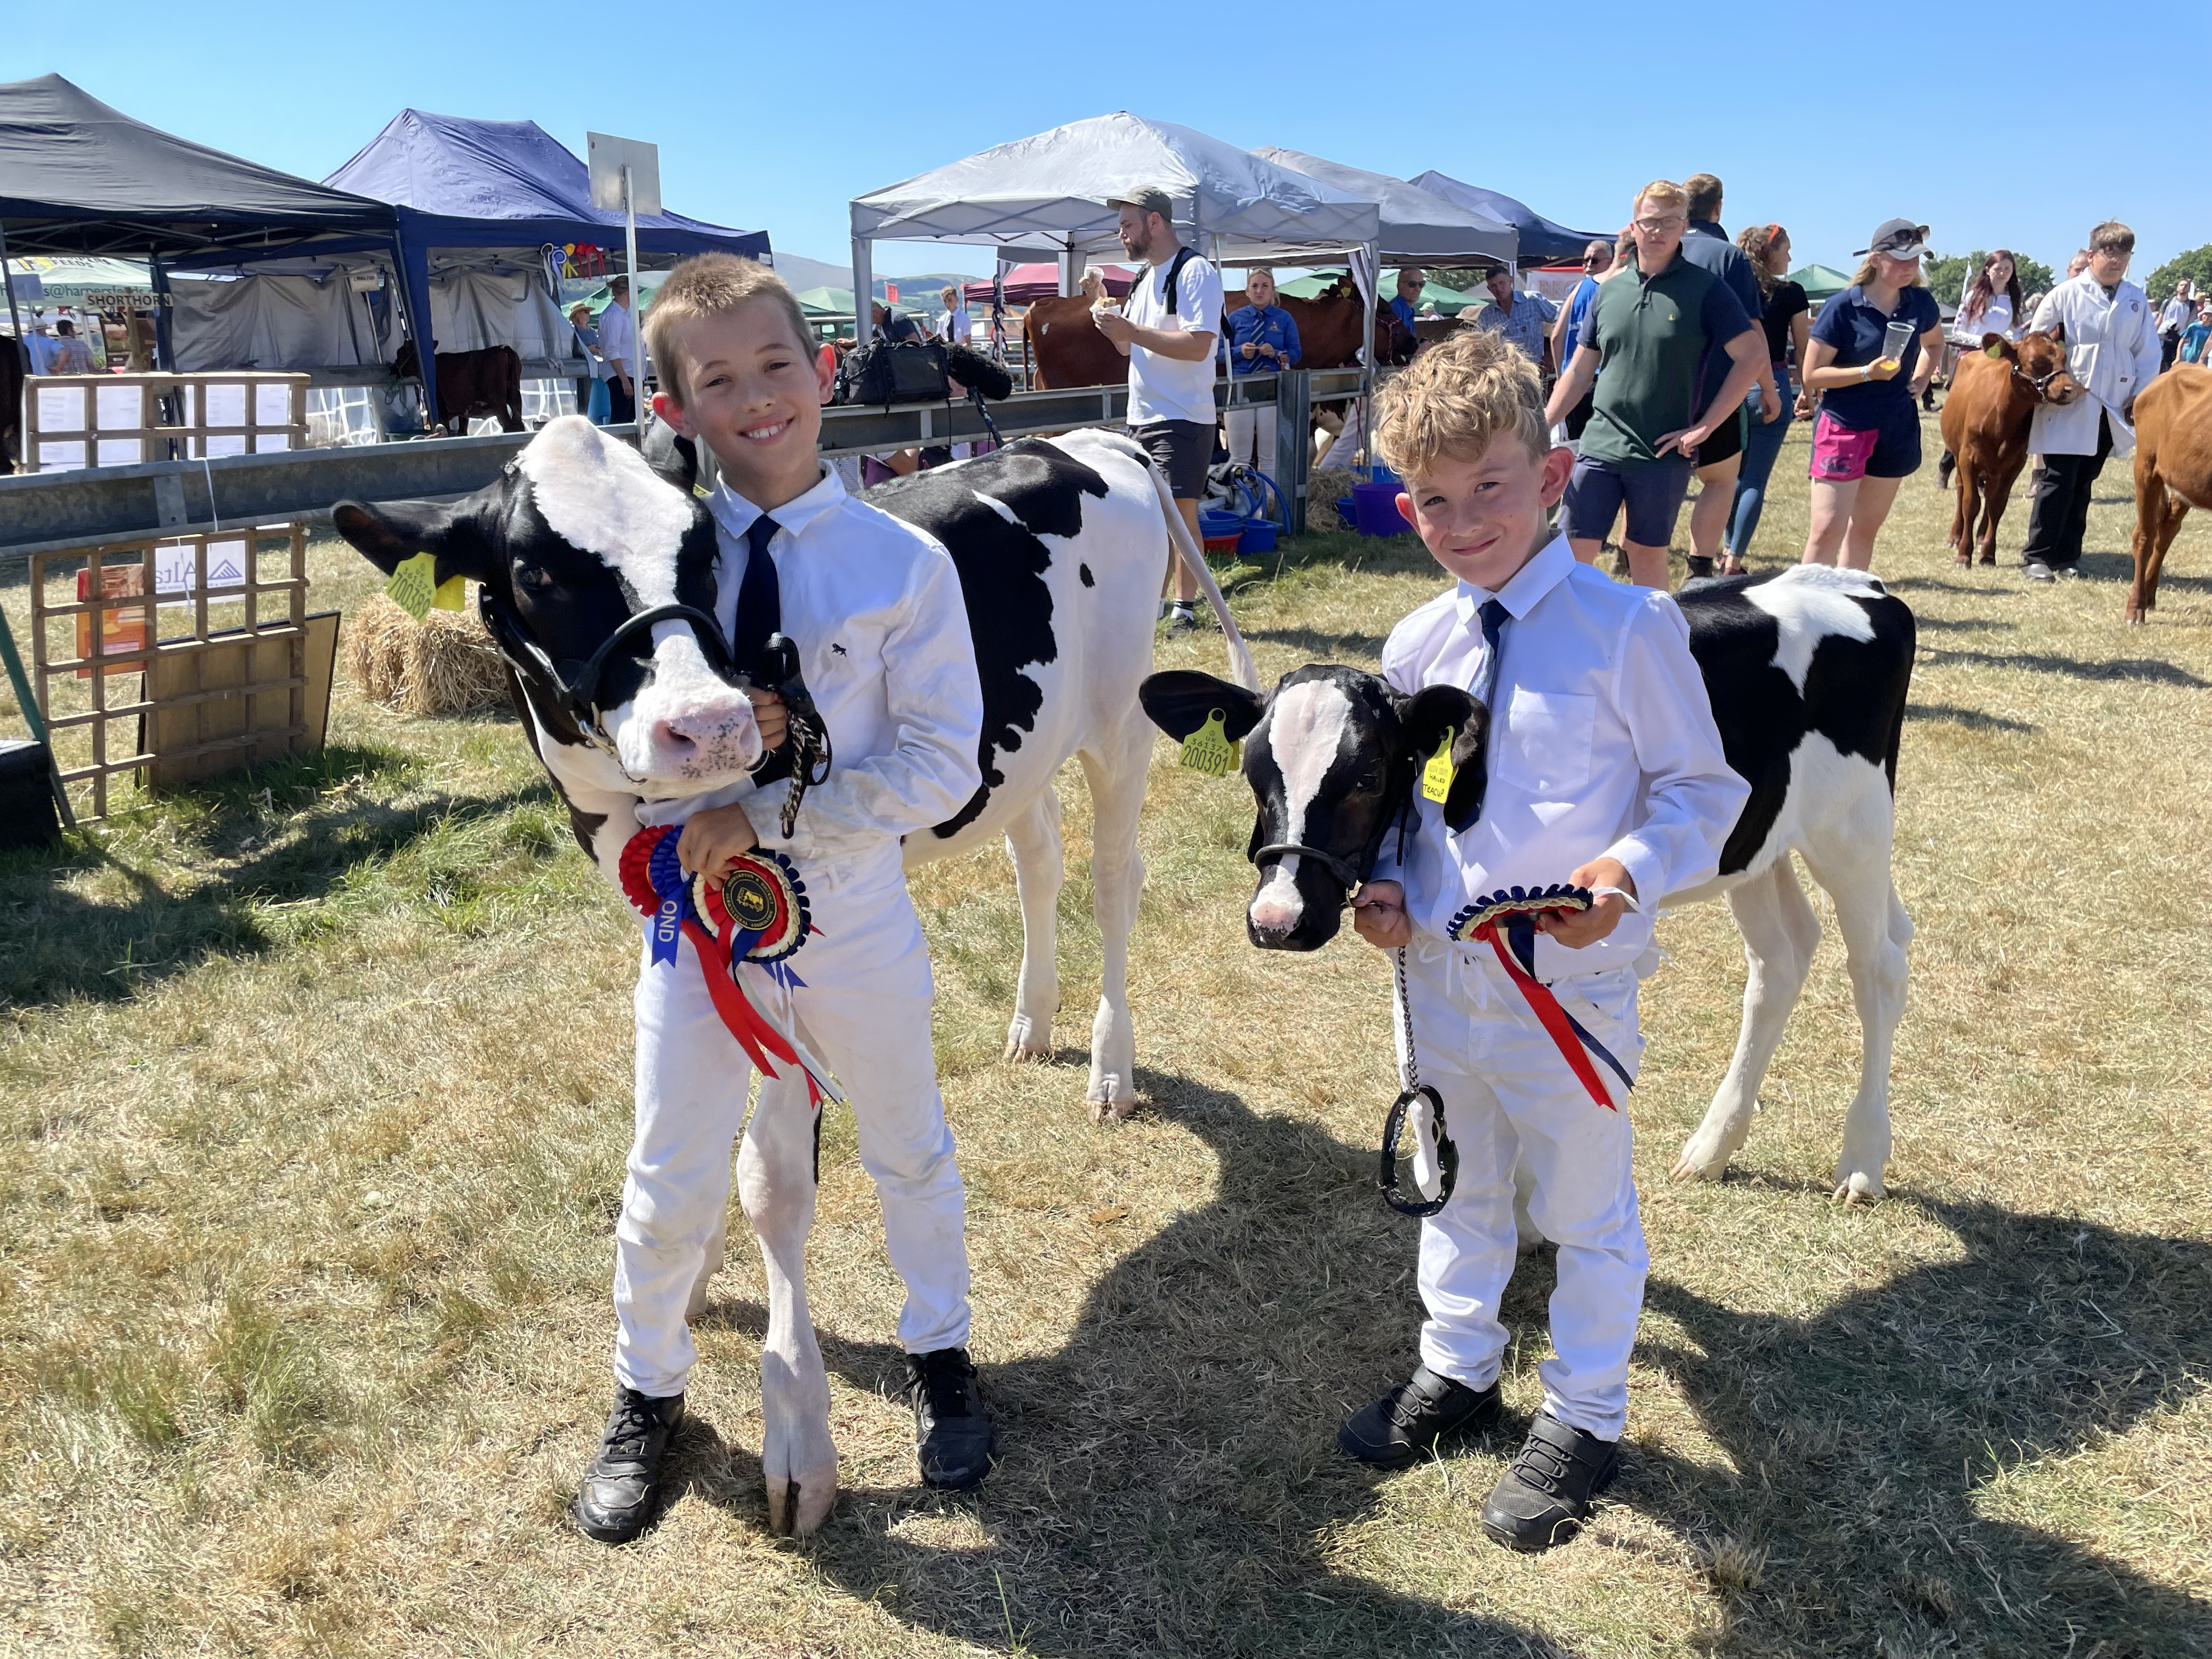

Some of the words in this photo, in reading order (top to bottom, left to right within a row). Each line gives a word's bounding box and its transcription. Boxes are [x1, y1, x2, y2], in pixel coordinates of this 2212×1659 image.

[88, 295, 171, 306] SHORTHORN
[1191, 738, 1228, 754] 361374
[1181, 744, 1228, 777] 200391
[1423, 783, 1444, 797] TEACUP
